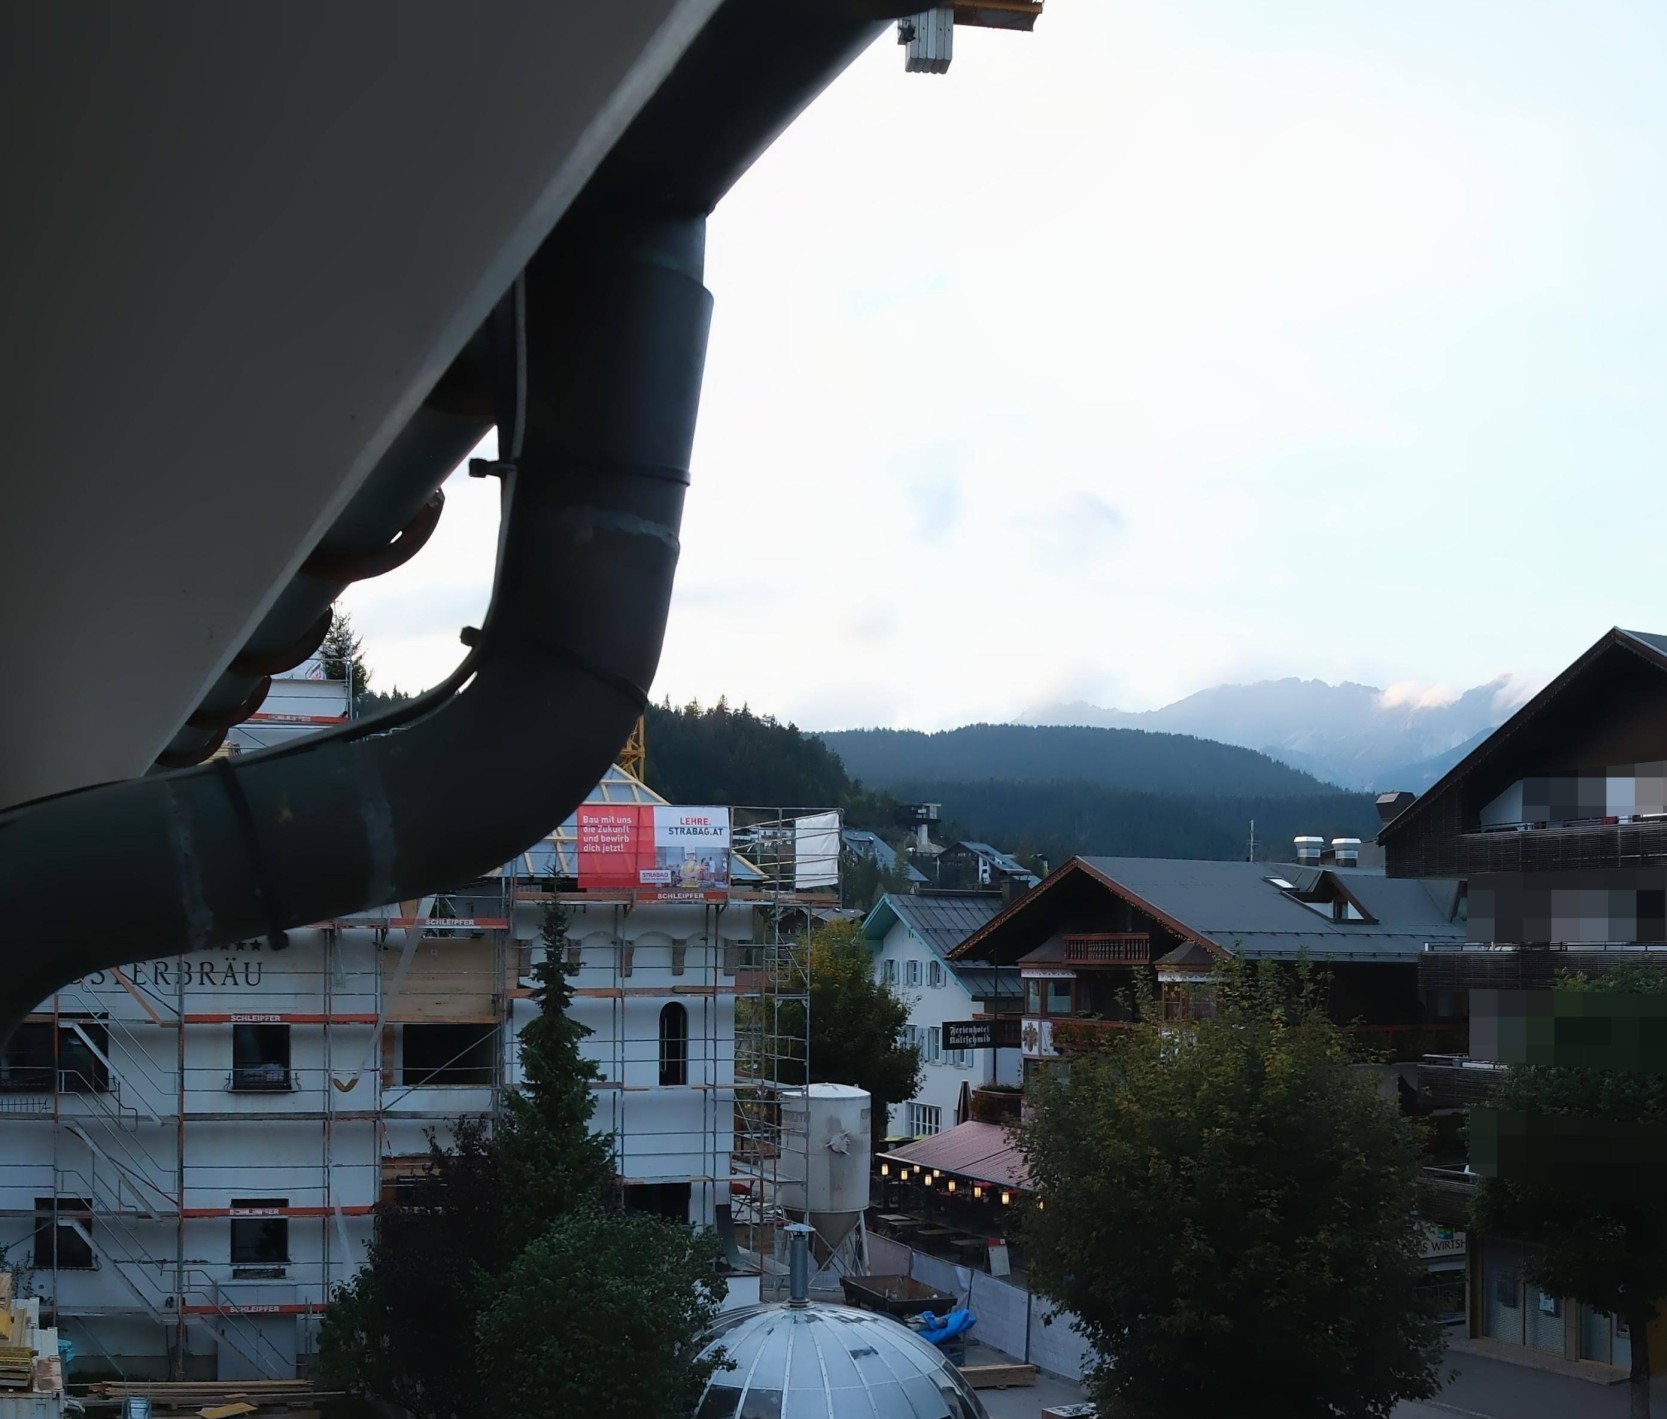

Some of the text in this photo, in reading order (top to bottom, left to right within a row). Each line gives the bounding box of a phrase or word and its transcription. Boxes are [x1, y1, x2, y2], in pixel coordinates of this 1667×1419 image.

[583, 816, 599, 824] Bau
[601, 816, 615, 824] mit
[680, 817, 711, 826] LEHRE.
[583, 825, 630, 833] die Zukunft
[668, 827, 723, 837] STRABAG.AT
[583, 835, 630, 843] und bewirb
[583, 844, 624, 853] dich jetzt!
[657, 892, 704, 900] SCHLEIPFER
